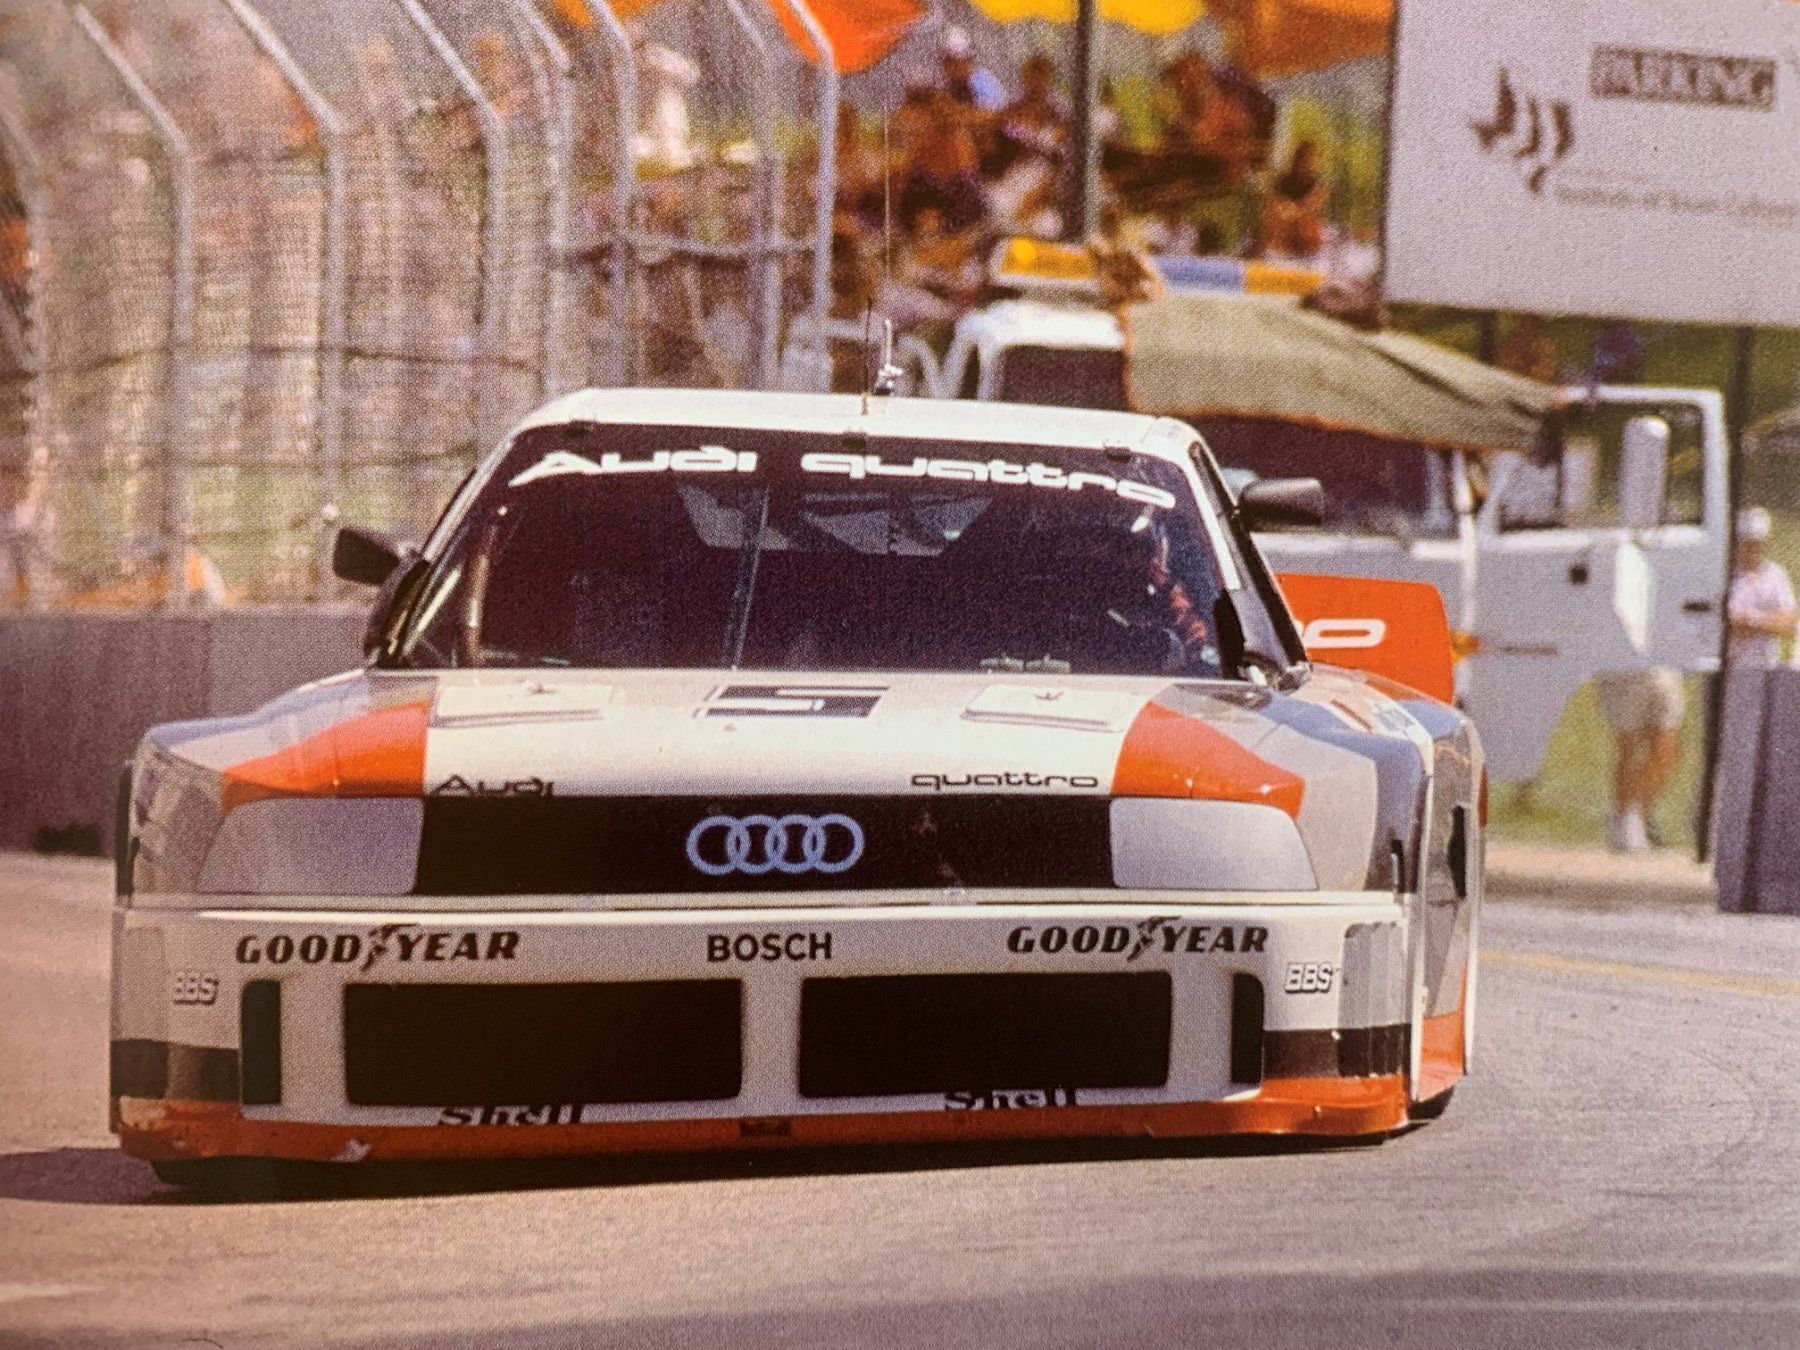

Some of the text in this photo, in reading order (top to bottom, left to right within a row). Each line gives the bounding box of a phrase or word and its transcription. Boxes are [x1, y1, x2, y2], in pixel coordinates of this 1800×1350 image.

[508, 445, 1175, 509] Audi quattro
[429, 775, 554, 798] Audi
[911, 772, 1099, 791] quattro
[706, 932, 832, 961] BOSCH
